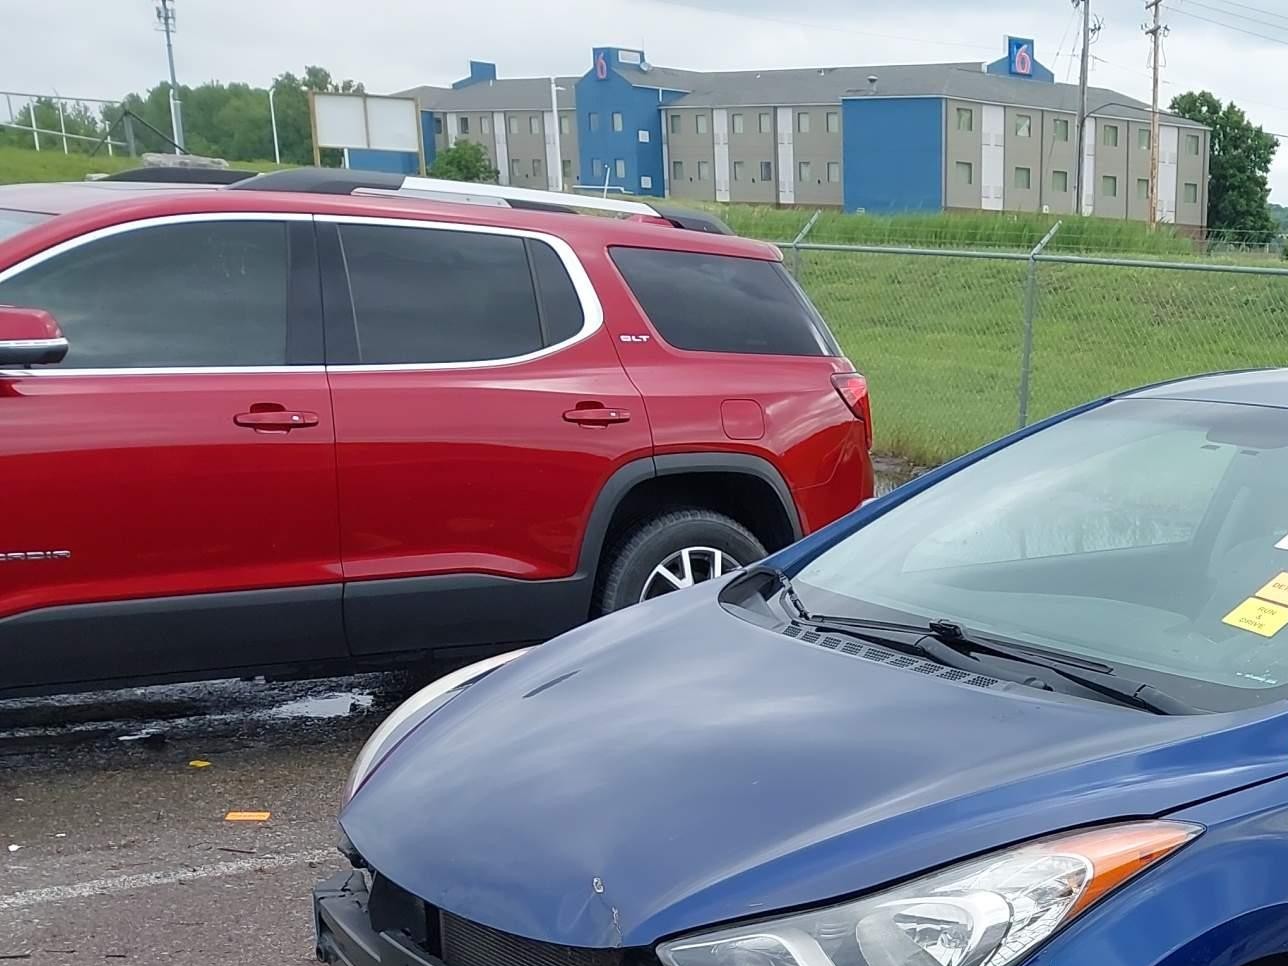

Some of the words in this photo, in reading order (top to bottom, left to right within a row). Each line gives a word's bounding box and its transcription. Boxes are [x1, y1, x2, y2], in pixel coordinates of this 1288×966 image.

[596, 51, 607, 80] 6
[1015, 44, 1031, 74] 6
[1257, 606, 1277, 616] RUN
[1239, 617, 1265, 630] DRIVE
